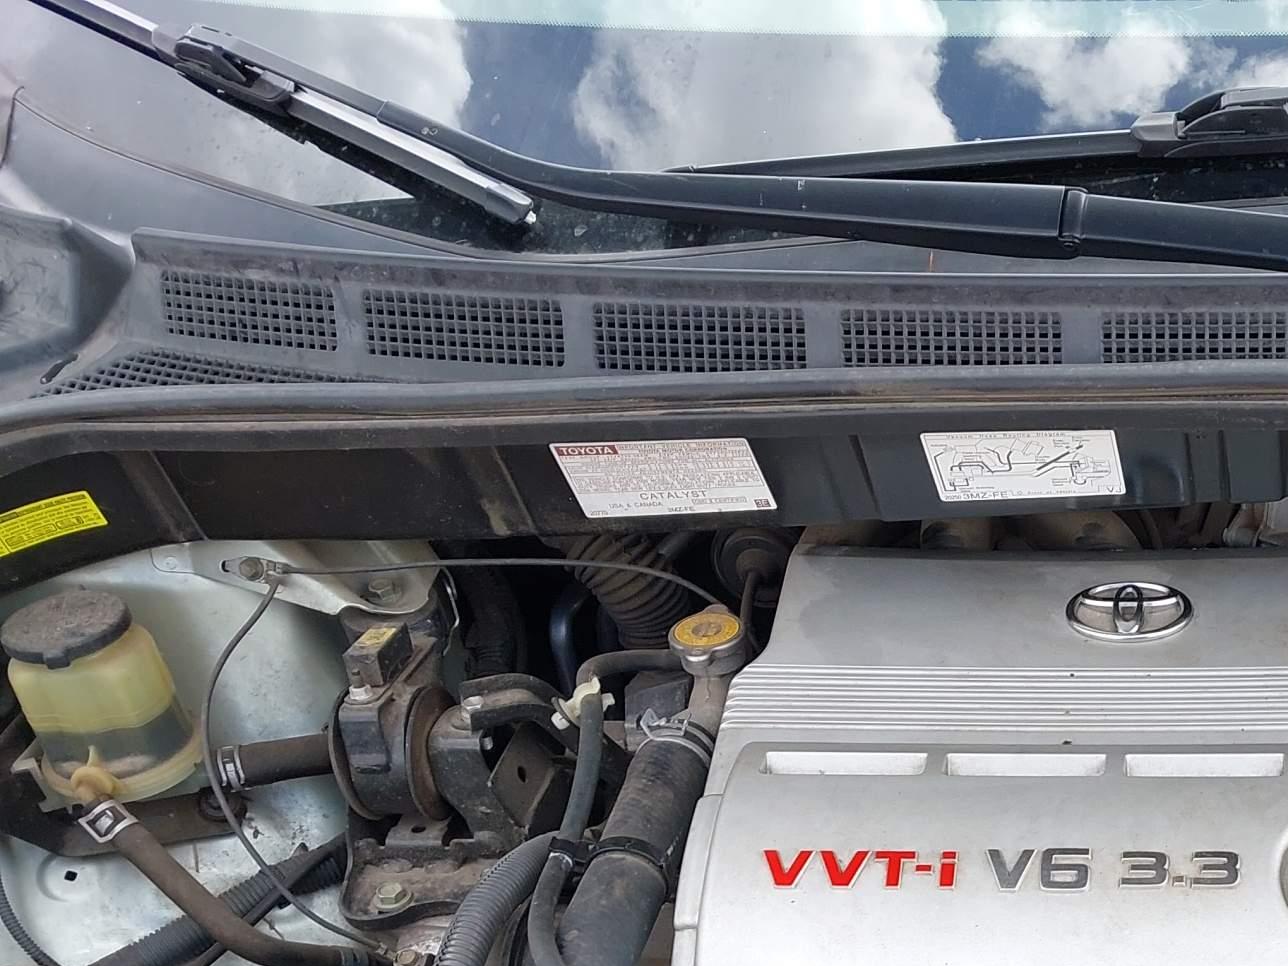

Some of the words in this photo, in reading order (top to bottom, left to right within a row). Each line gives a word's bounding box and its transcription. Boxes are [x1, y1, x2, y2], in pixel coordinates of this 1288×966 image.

[559, 446, 613, 455] TOYOTA
[639, 490, 707, 500] CATALYST
[963, 491, 1009, 500] 3MZ-FE
[763, 848, 960, 889] VVT-i
[985, 847, 1093, 892] V6
[1119, 850, 1242, 891] 3.3
